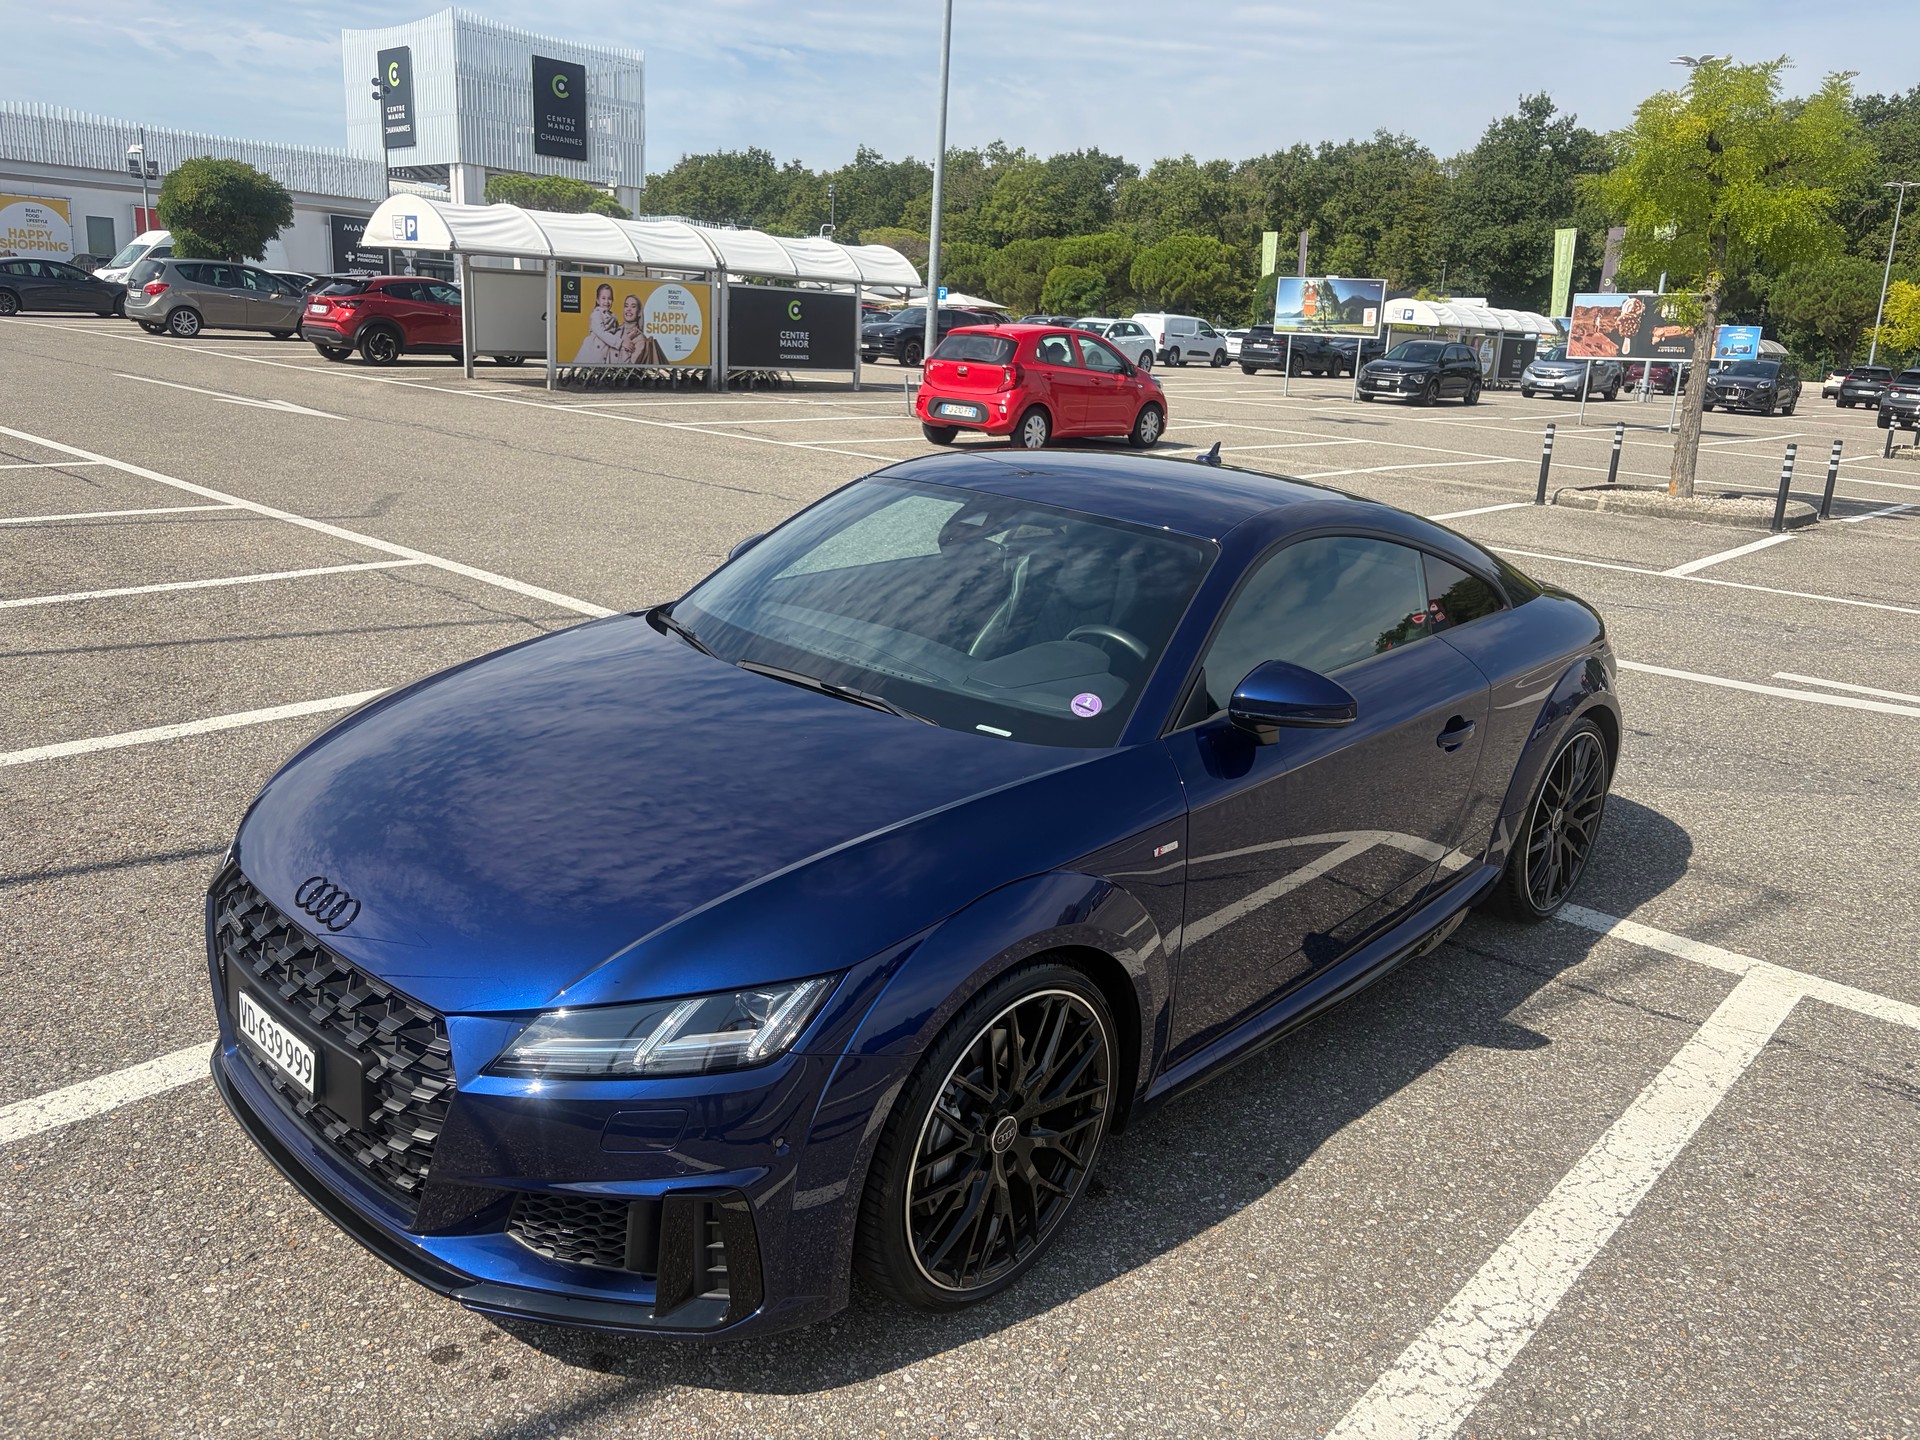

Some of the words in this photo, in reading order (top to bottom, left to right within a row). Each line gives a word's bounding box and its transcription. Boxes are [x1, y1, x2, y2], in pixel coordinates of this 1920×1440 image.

[387, 105, 405, 113] CENTRE
[388, 112, 405, 120] MANOR
[546, 114, 576, 126] CENTRE
[547, 122, 576, 133] MANOR
[541, 133, 583, 146] CHAVANNES
[343, 224, 366, 232] MAN
[406, 219, 416, 238] P
[8, 228, 52, 240] HAPPY
[0, 238, 69, 252] SHOPPING
[356, 252, 384, 260] PHARMACIE
[356, 257, 384, 265] PRINCIPALE
[940, 290, 946, 299] P
[653, 311, 688, 324] HAPPY
[1404, 310, 1412, 319] P
[646, 322, 700, 336] SHOPPING
[780, 330, 810, 340] CENTRE
[780, 339, 809, 349] MANOR
[285, 1038, 313, 1084] 999
